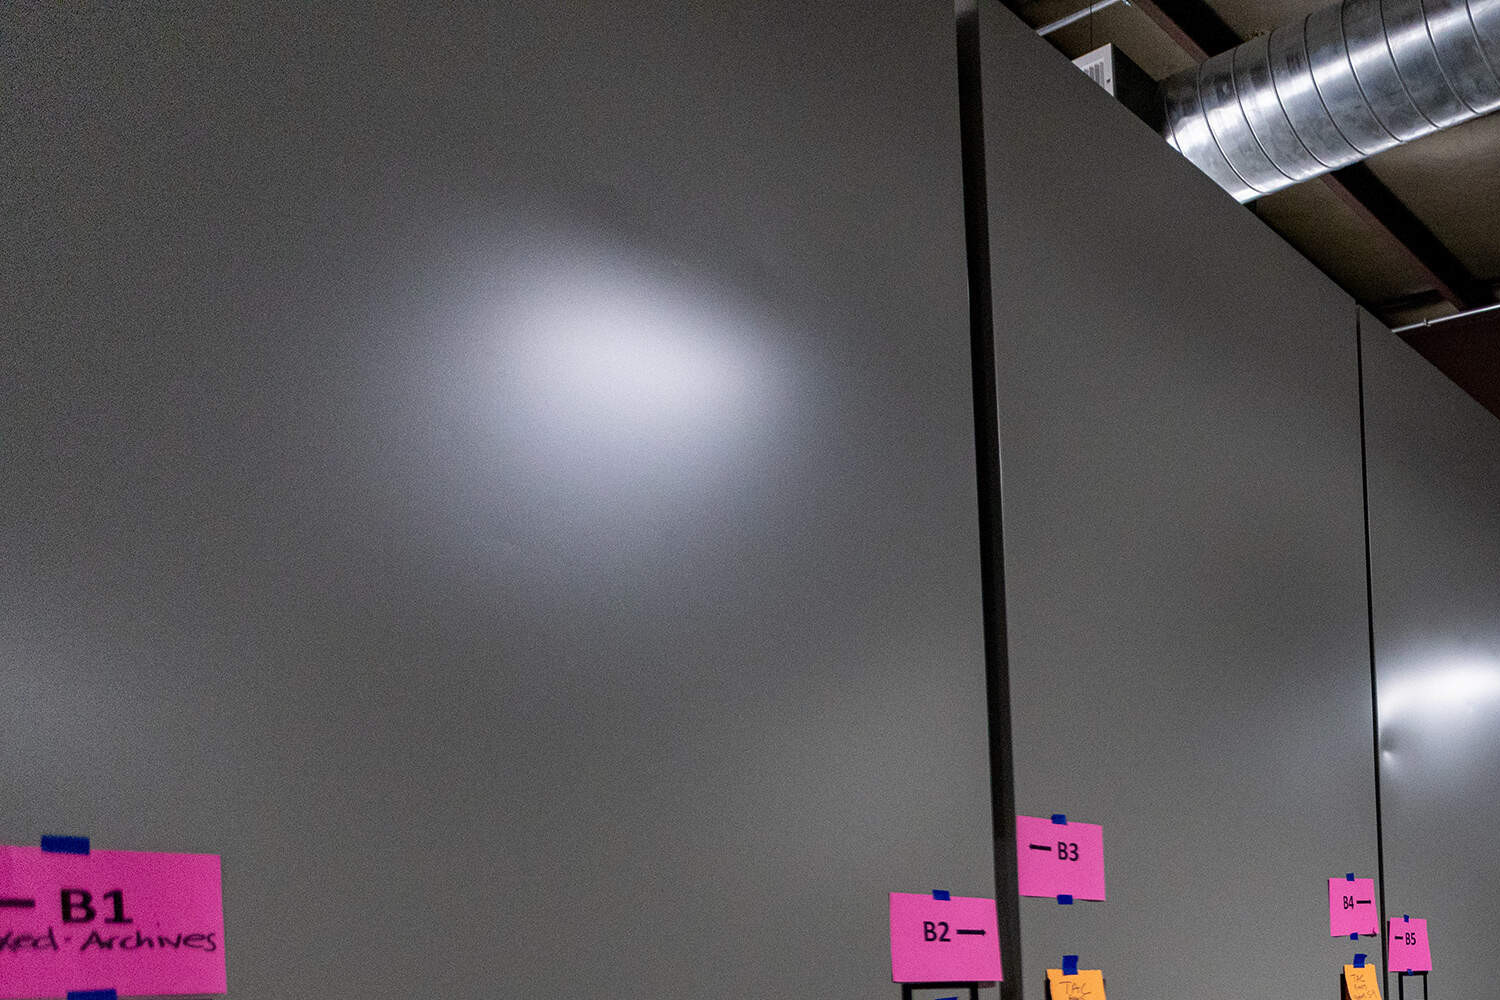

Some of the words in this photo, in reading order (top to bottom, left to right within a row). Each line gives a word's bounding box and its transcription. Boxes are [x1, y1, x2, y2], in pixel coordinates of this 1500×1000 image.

[1057, 841, 1080, 862] B3
[60, 887, 134, 925] B1
[1342, 895, 1355, 910] B4
[923, 921, 951, 942] B2
[1405, 932, 1417, 946] B5
